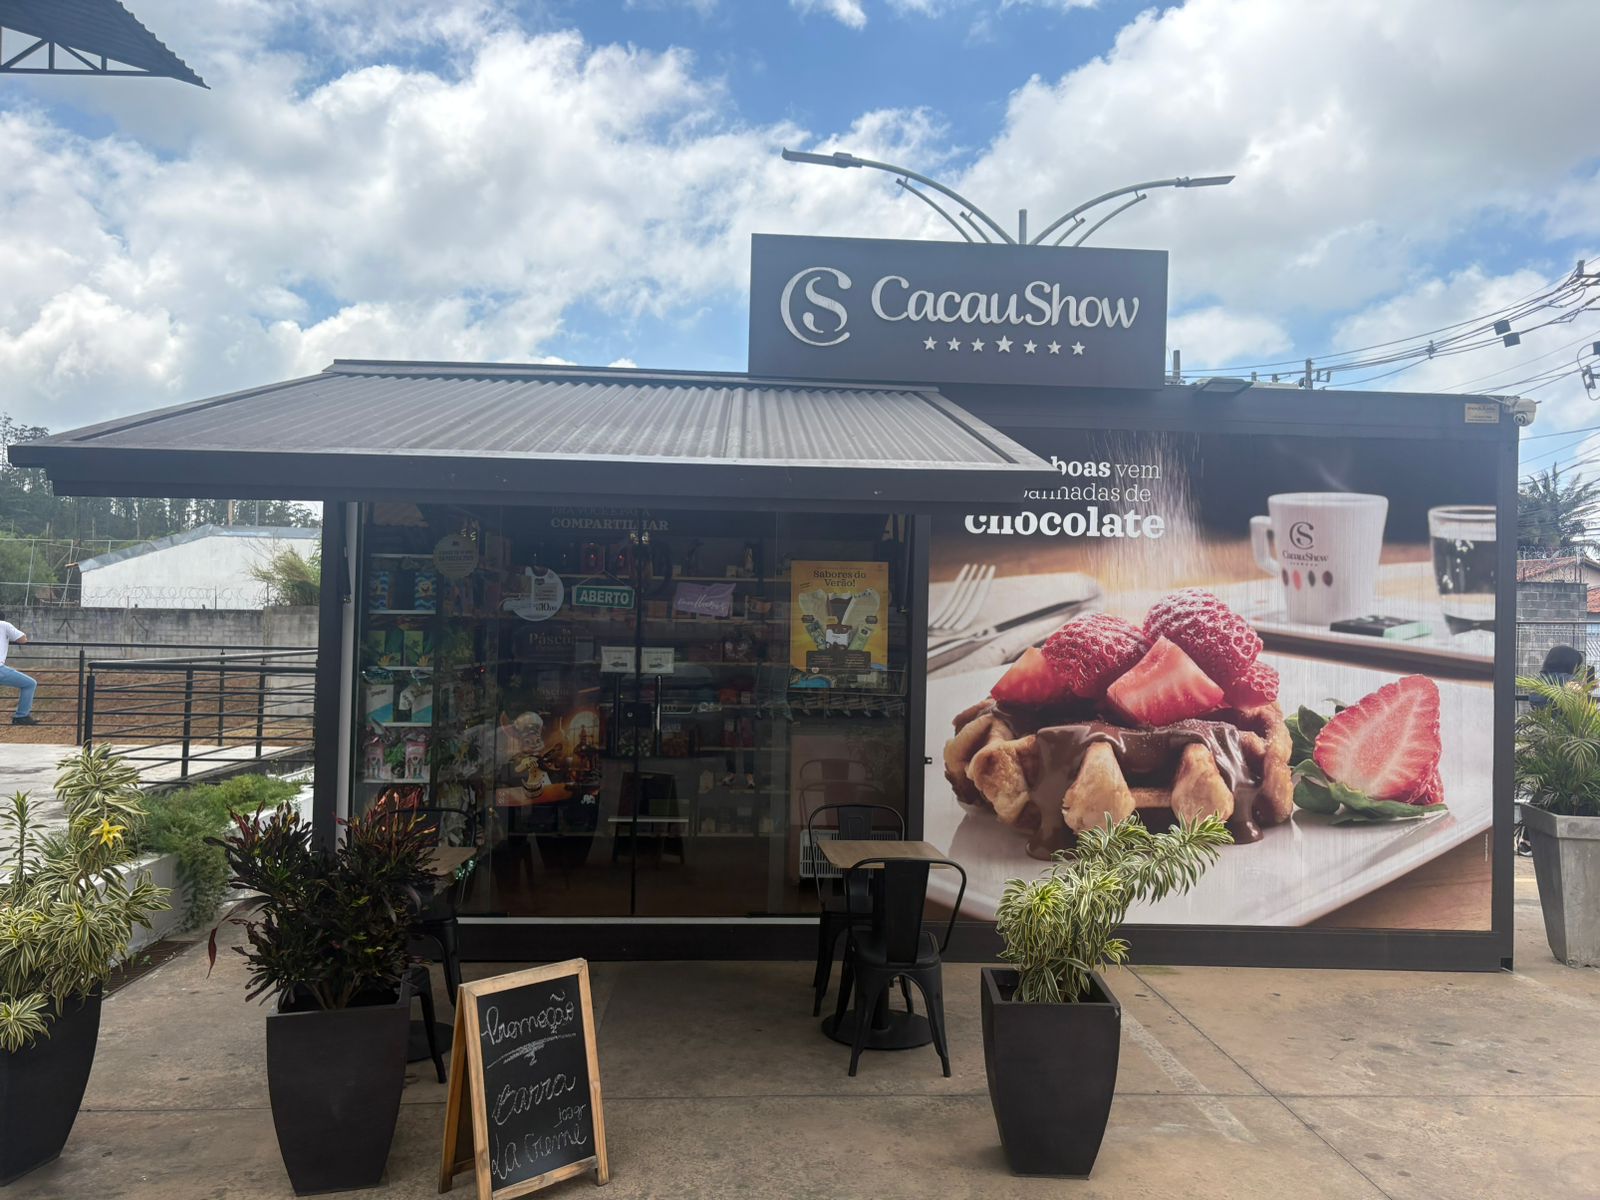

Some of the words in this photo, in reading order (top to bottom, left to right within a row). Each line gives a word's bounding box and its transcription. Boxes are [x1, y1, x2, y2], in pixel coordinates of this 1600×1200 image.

[1115, 463, 1162, 479] vem
[1125, 485, 1152, 502] de
[965, 506, 1165, 539] chocolate
[813, 569, 853, 579] Sabores
[854, 571, 867, 579] do
[824, 578, 856, 587] Verão!
[579, 590, 630, 605] ABERTO
